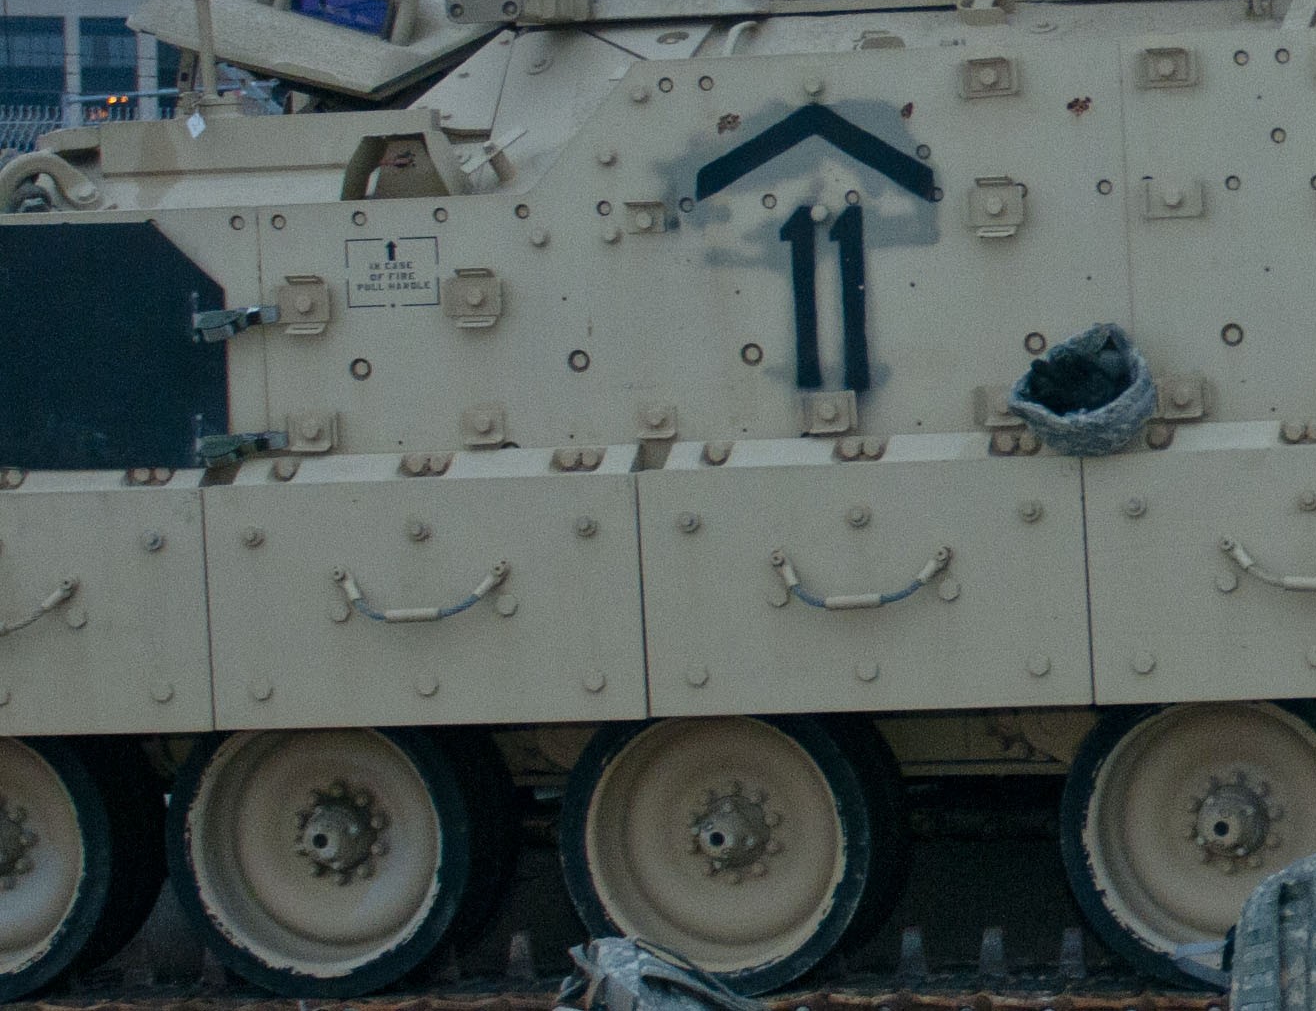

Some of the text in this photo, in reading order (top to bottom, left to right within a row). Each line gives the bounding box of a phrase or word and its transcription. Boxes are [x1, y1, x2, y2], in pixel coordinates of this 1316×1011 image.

[369, 261, 414, 270] IN CASE
[369, 272, 415, 281] OF FIRE
[357, 281, 430, 291] PULL HANDLE
[779, 205, 870, 390] 11
